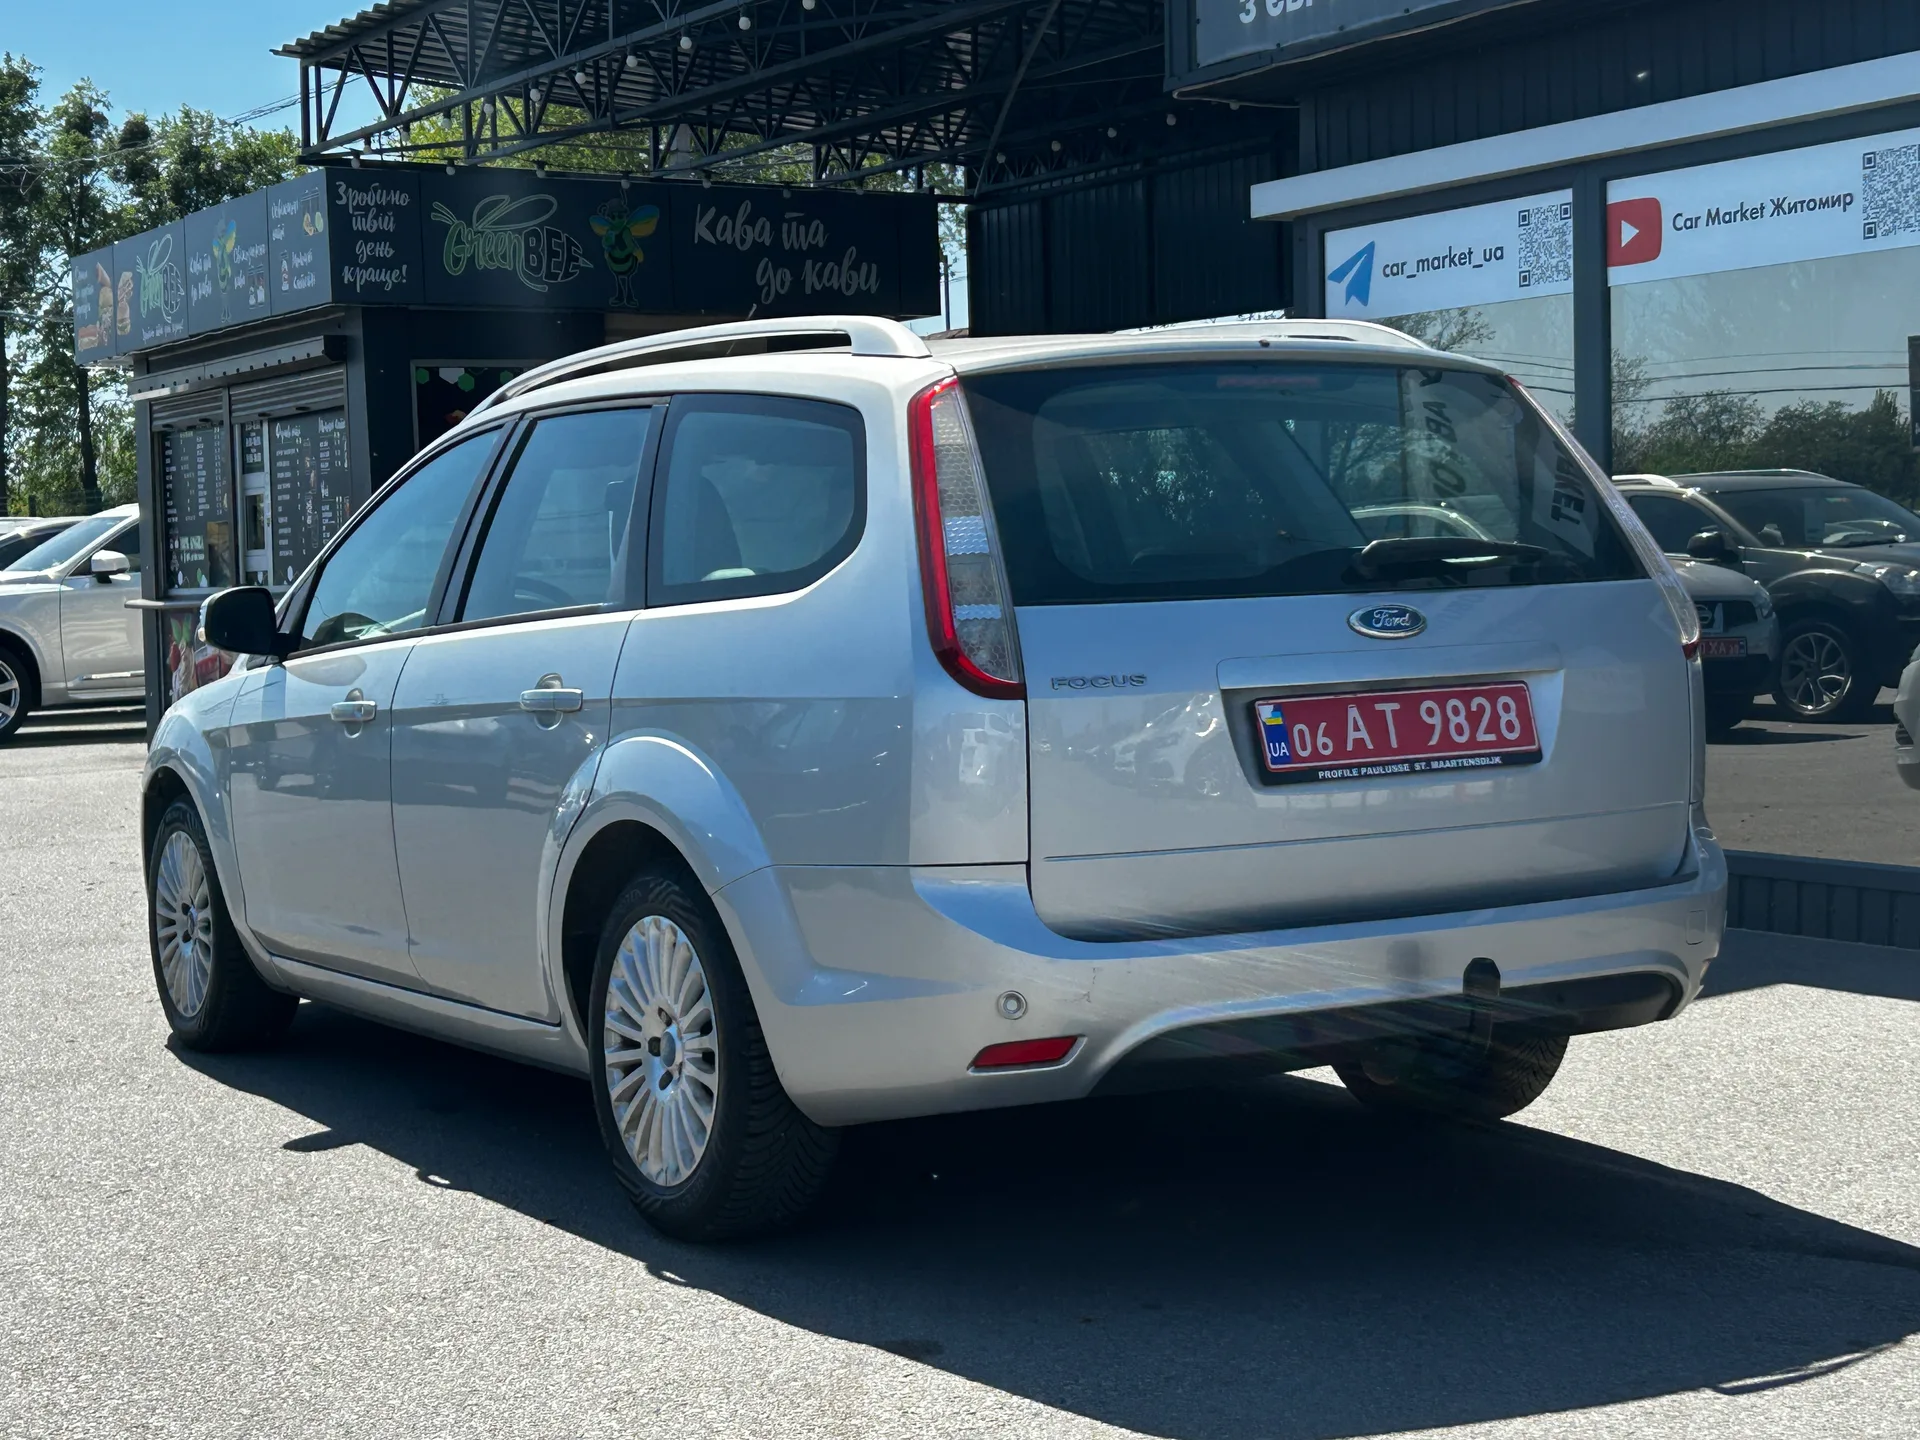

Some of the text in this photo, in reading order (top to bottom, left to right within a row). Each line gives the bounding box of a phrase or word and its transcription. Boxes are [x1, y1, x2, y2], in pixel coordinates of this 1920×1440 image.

[335, 181, 411, 214] Зробимо
[1672, 192, 1854, 231] Car Market Житомир
[352, 207, 396, 232] твій
[694, 199, 830, 251] Кава та
[355, 240, 396, 264] день
[1382, 245, 1504, 279] car_market_ua
[341, 264, 408, 293] краще!
[755, 246, 880, 305] до кави
[1371, 609, 1412, 628] Ford
[1051, 673, 1148, 690] FOCUS
[1270, 695, 1521, 757] UA 06 AT 9828
[1318, 768, 1359, 779] PROFILE
[1414, 762, 1429, 771] ST.
